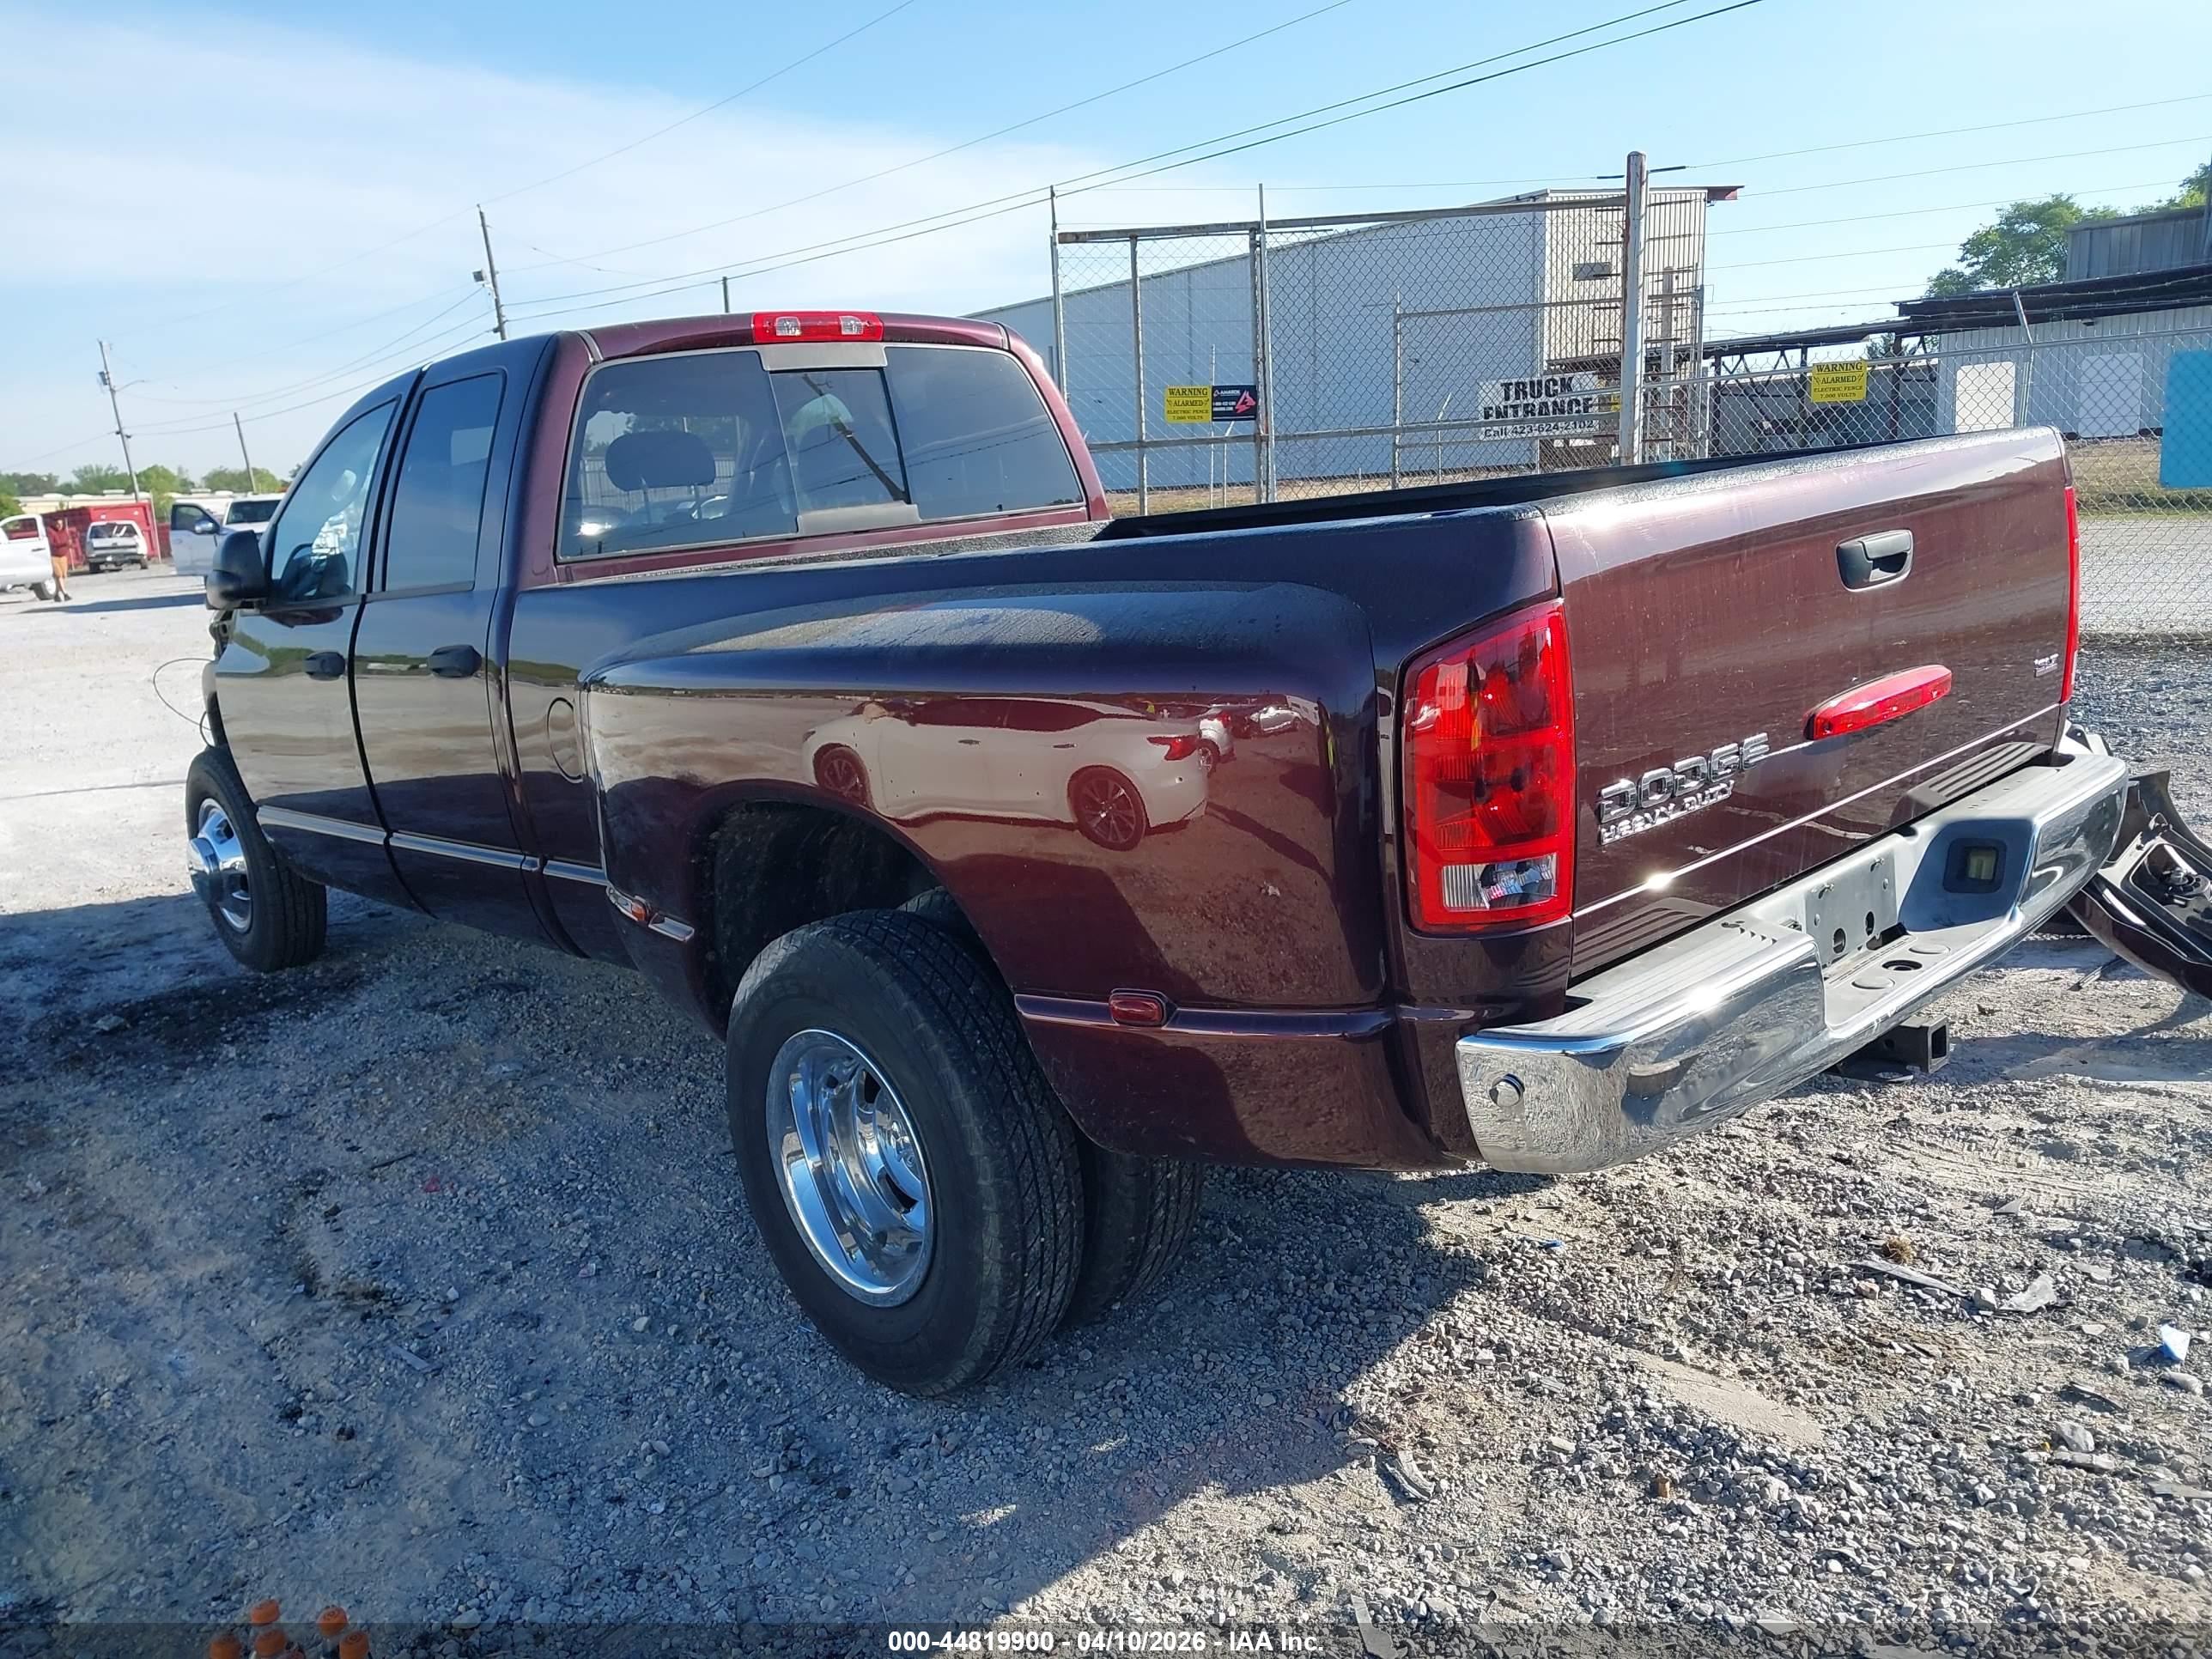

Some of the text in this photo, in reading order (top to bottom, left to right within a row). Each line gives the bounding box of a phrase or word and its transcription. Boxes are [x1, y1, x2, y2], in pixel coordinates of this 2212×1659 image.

[1816, 362, 1863, 372] WARNING
[1821, 375, 1856, 384] ALARMED
[1168, 387, 1208, 396] WARNING
[1501, 376, 1574, 401] TRUCK
[1483, 397, 1593, 420] ENTRANCE
[1485, 427, 1508, 438] Call
[1598, 732, 1770, 823] DODGE
[1599, 780, 1735, 846] HEAVY DUTY
